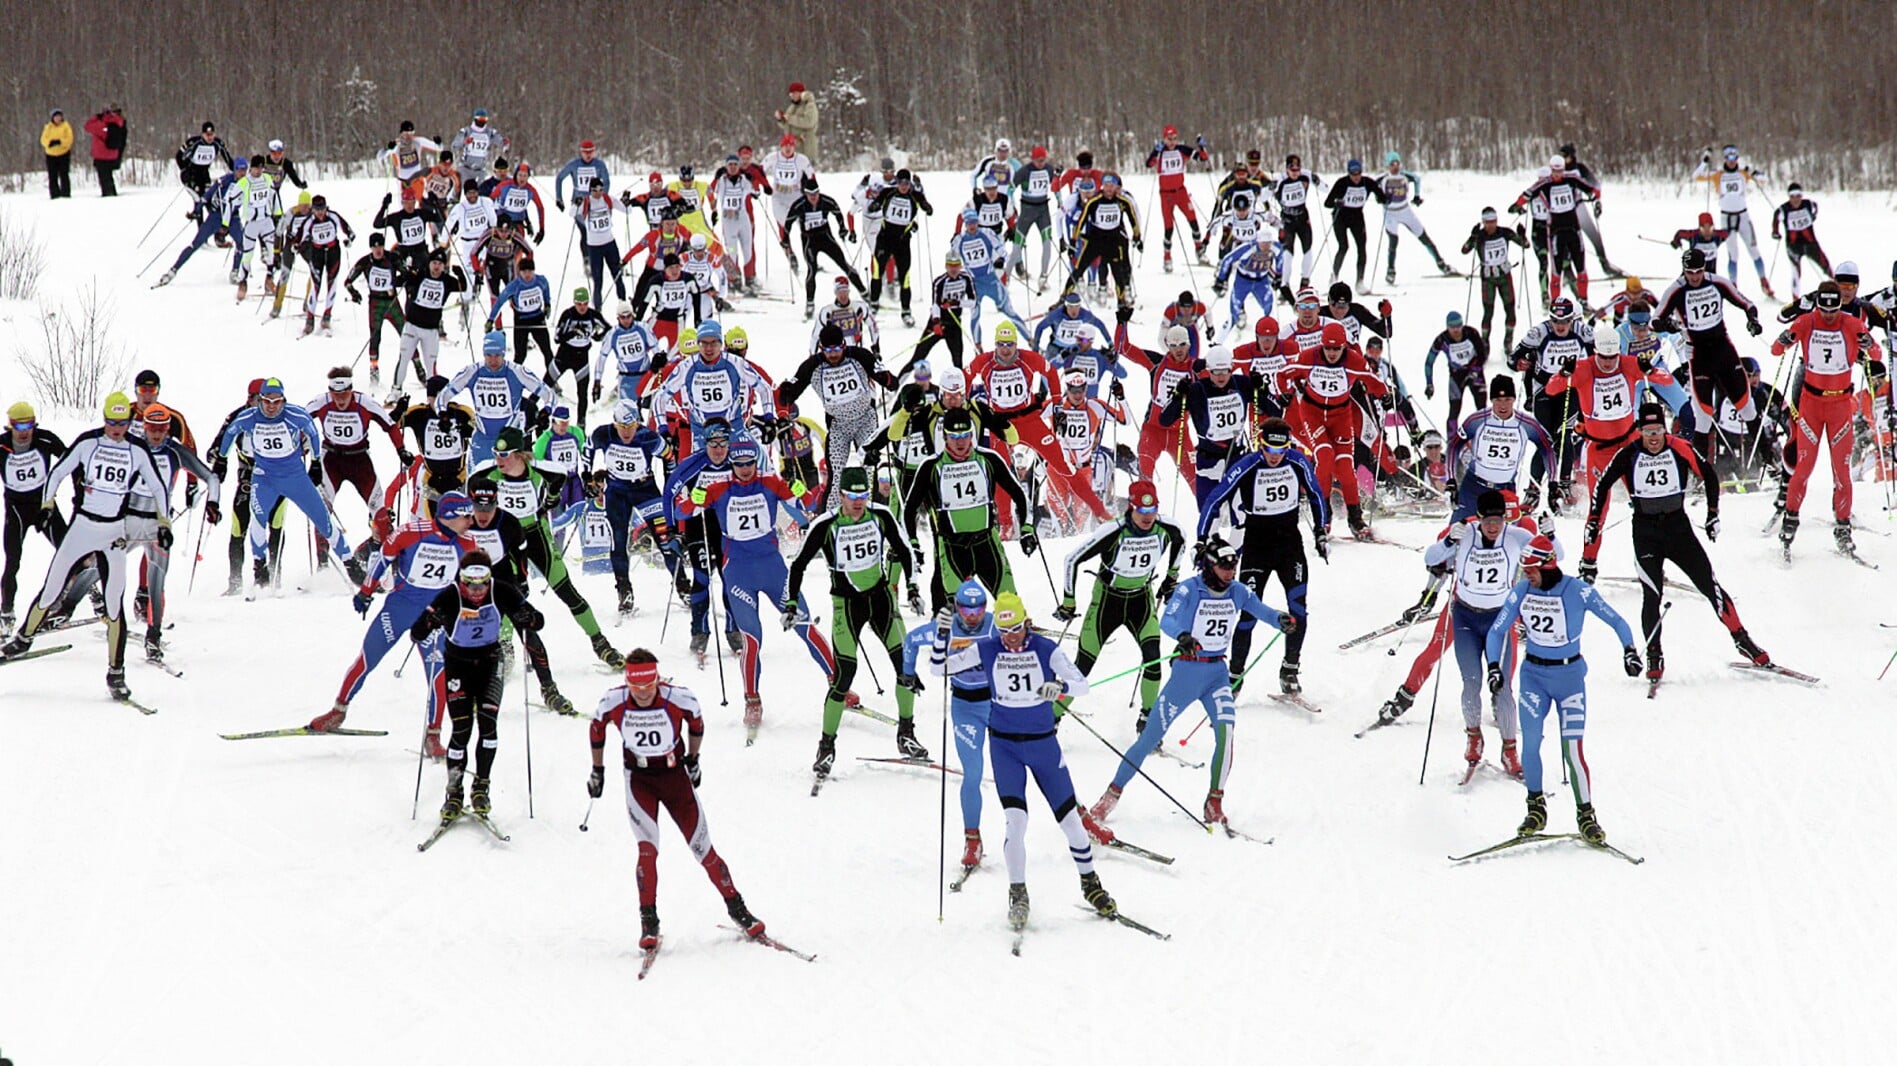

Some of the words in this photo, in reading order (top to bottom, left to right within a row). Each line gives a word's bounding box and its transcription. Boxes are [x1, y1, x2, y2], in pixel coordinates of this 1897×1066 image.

[1164, 159, 1181, 168] 197
[778, 170, 795, 180] 177
[1726, 183, 1739, 193] 90
[508, 197, 526, 208] 199
[727, 198, 742, 208] 181
[1554, 194, 1573, 208] 161
[891, 207, 908, 218] 141
[469, 216, 486, 227] 150
[404, 226, 423, 237] 139
[1236, 228, 1254, 237] 170
[966, 249, 986, 260] 127
[374, 277, 386, 286] 87
[422, 289, 442, 302] 192
[666, 292, 684, 302] 134
[1691, 302, 1720, 320] 122
[621, 344, 642, 356] 166
[1823, 348, 1832, 364] 7
[828, 379, 858, 394] 120
[996, 383, 1023, 398] 110
[1320, 380, 1338, 392] 15
[478, 394, 508, 407] 103
[702, 388, 723, 402] 56
[1210, 396, 1238, 406] American
[1602, 392, 1623, 410] 54
[1216, 412, 1237, 428] 30
[334, 426, 354, 438] 50
[263, 437, 283, 450] 36
[434, 434, 452, 448] 86
[1482, 436, 1519, 444] Birkebeiner
[98, 448, 128, 458] American
[558, 451, 572, 462] 49
[1487, 444, 1511, 458] 53
[94, 455, 130, 466] Birkebeiner
[615, 460, 636, 472] 38
[94, 465, 127, 482] 169
[946, 463, 976, 473] American
[1259, 468, 1290, 478] American
[16, 467, 38, 482] 64
[944, 470, 980, 480] Birkebeiner
[1227, 466, 1242, 484] APU
[1645, 470, 1668, 487] 43
[1257, 476, 1294, 486] Birkebeiner
[670, 480, 682, 494] APU
[952, 480, 977, 500] 14
[1266, 484, 1290, 502] 59
[504, 496, 527, 509] 35
[732, 498, 762, 506] American
[730, 504, 764, 512] Birkebeiner
[738, 514, 760, 530] 21
[841, 525, 872, 536] American
[839, 531, 877, 542] Birkebeiner
[1125, 537, 1156, 546] American
[422, 546, 453, 554] American
[843, 540, 878, 561] 156
[1122, 544, 1159, 552] Birkebeiner
[418, 553, 455, 562] Birkebeiner
[1472, 550, 1502, 559] American
[1129, 553, 1152, 568] 19
[422, 563, 446, 579] 24
[1475, 568, 1498, 584] 12
[1202, 602, 1233, 610] American
[1527, 597, 1559, 605] American
[1199, 608, 1234, 616] Birkebeiner
[1522, 604, 1561, 614] Birkebeiner
[1205, 619, 1228, 636] 25
[1530, 616, 1555, 634] 22
[472, 628, 484, 639] 2
[999, 654, 1035, 663] American
[1008, 674, 1032, 692] 31
[1560, 692, 1585, 737] ITA
[634, 731, 661, 747] 20
